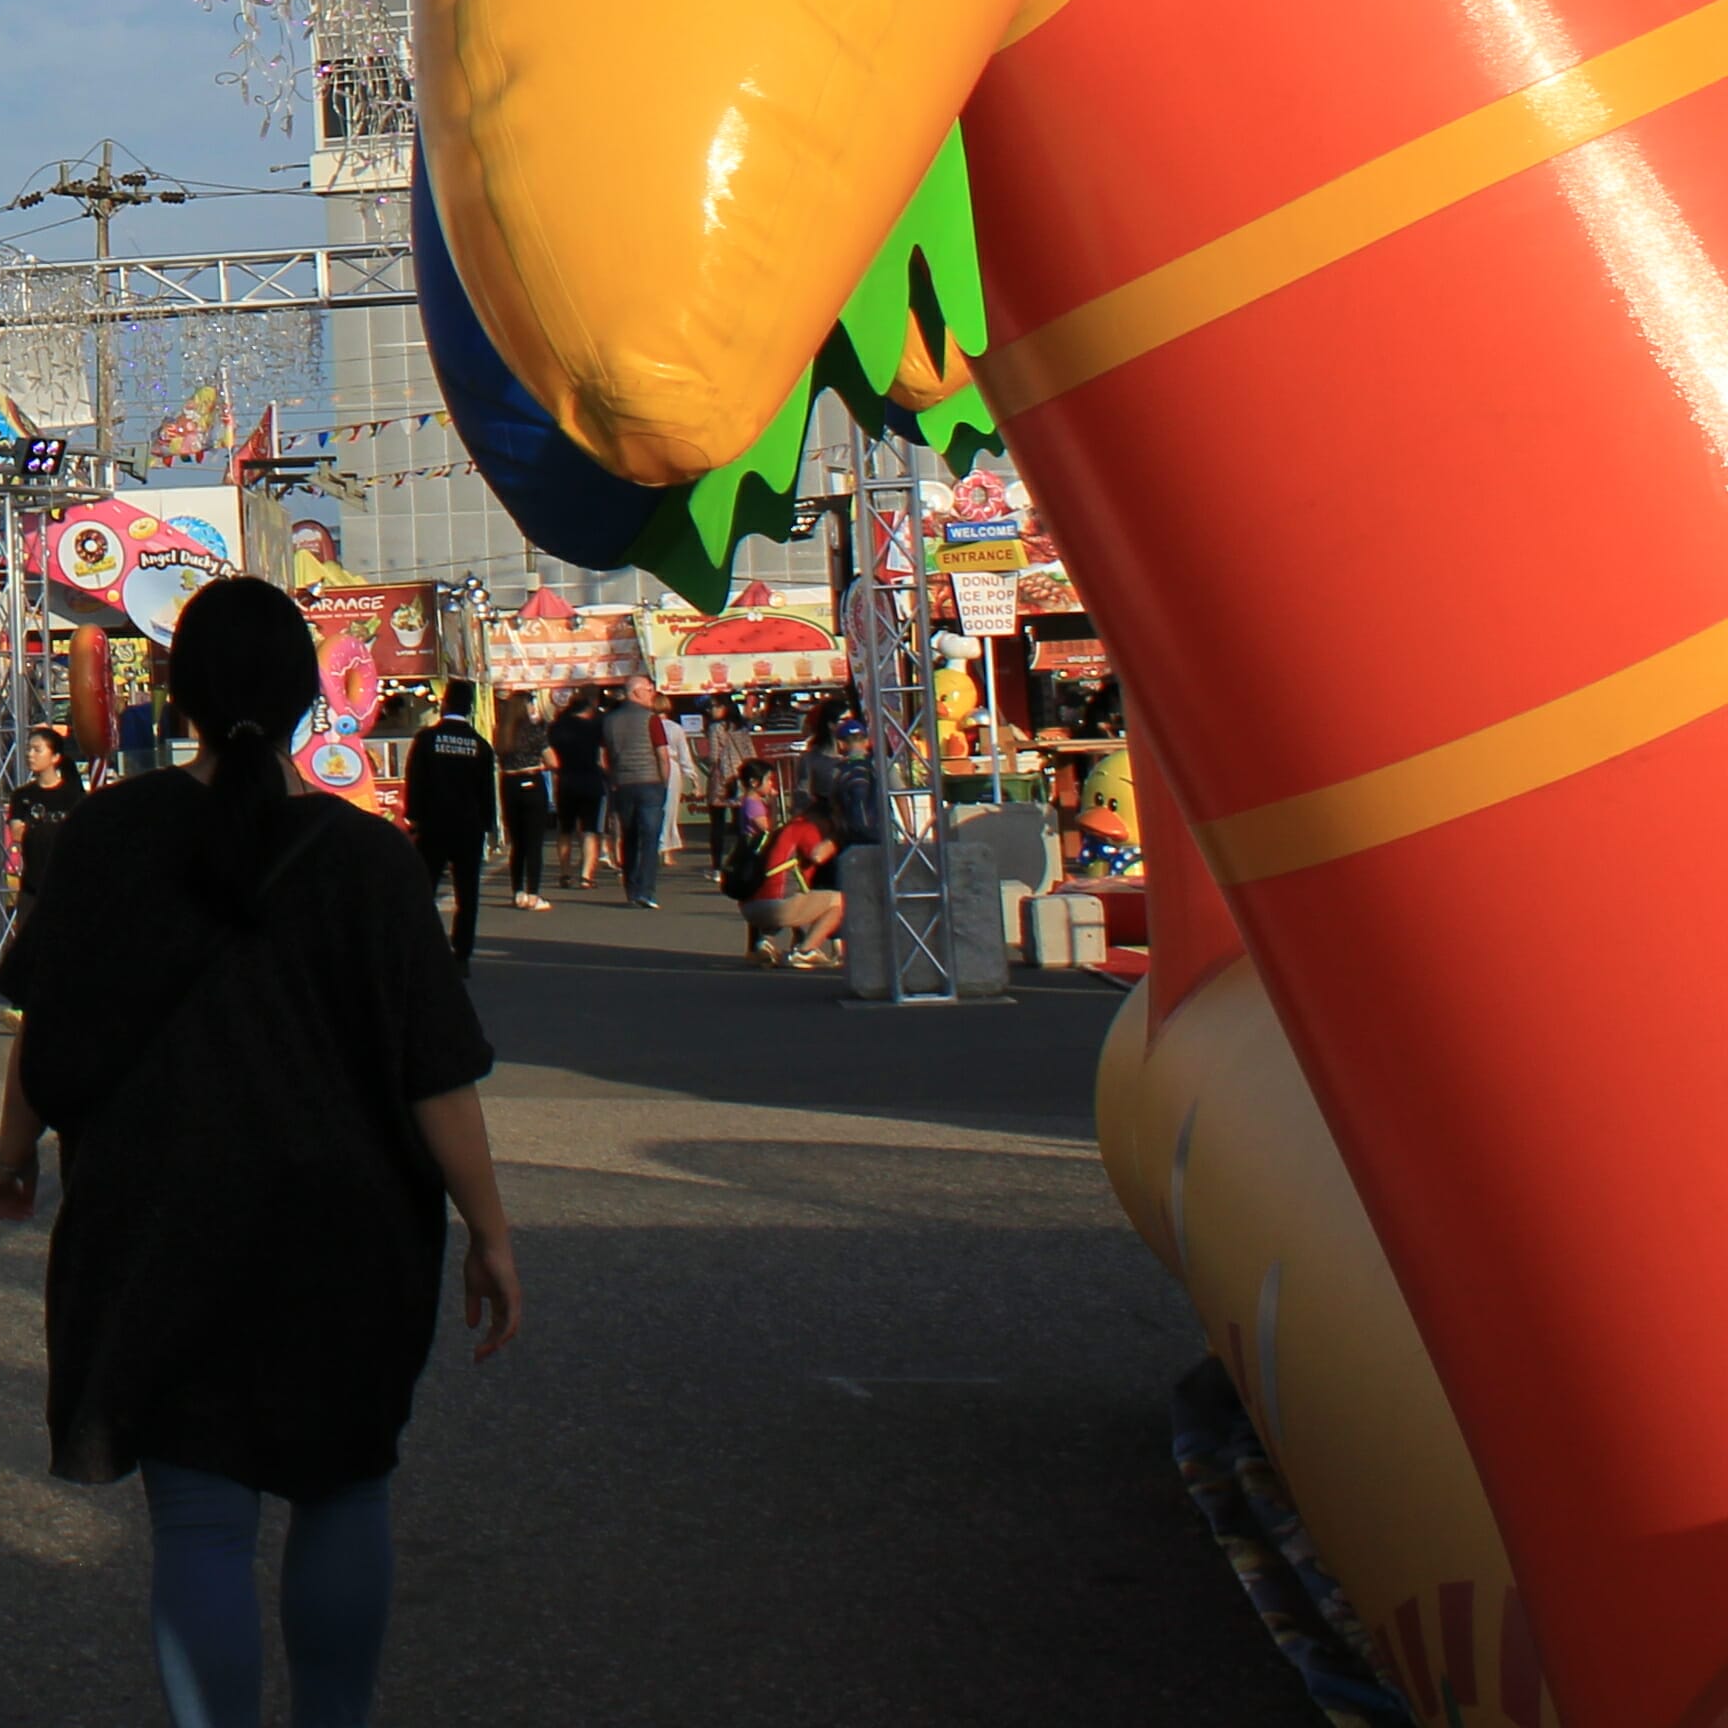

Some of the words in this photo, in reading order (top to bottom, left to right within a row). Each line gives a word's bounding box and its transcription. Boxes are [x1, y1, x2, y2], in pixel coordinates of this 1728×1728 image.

[949, 524, 1016, 539] WELCOME
[140, 549, 177, 569] Angel
[179, 550, 220, 575] Ducky
[942, 548, 1014, 565] ENTRANCE
[961, 575, 1007, 587] DONUT
[959, 591, 981, 601] ICE
[986, 590, 1015, 601] POP
[962, 604, 1014, 617] DRINKS
[963, 618, 1014, 631] GOODS
[436, 734, 478, 747] ARMOUR
[434, 743, 478, 757] SECURITY
